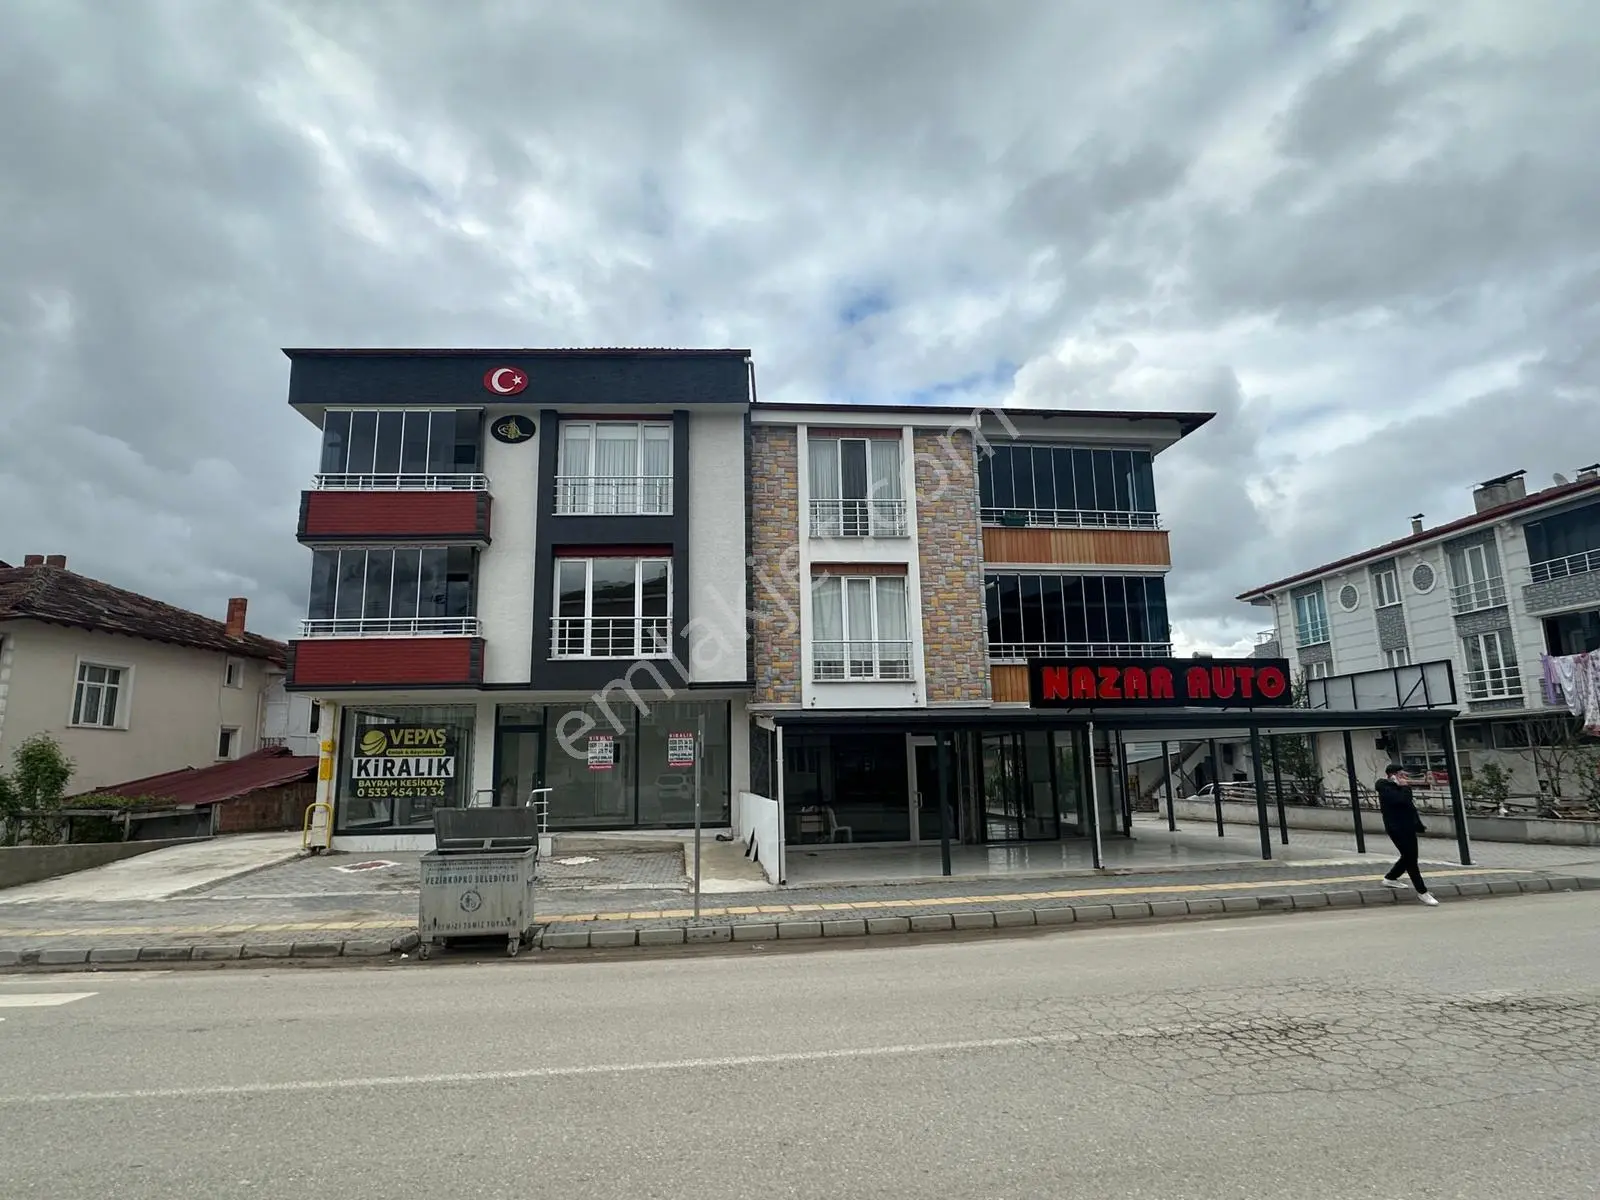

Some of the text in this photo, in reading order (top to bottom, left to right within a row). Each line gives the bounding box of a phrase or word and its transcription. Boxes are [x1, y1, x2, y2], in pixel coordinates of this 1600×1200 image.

[1041, 665, 1286, 699] NAZAR AUTO
[389, 728, 447, 748] VEPAŞ
[358, 779, 398, 787] BAYRAM
[357, 787, 445, 797] 0 533 454 12 34
